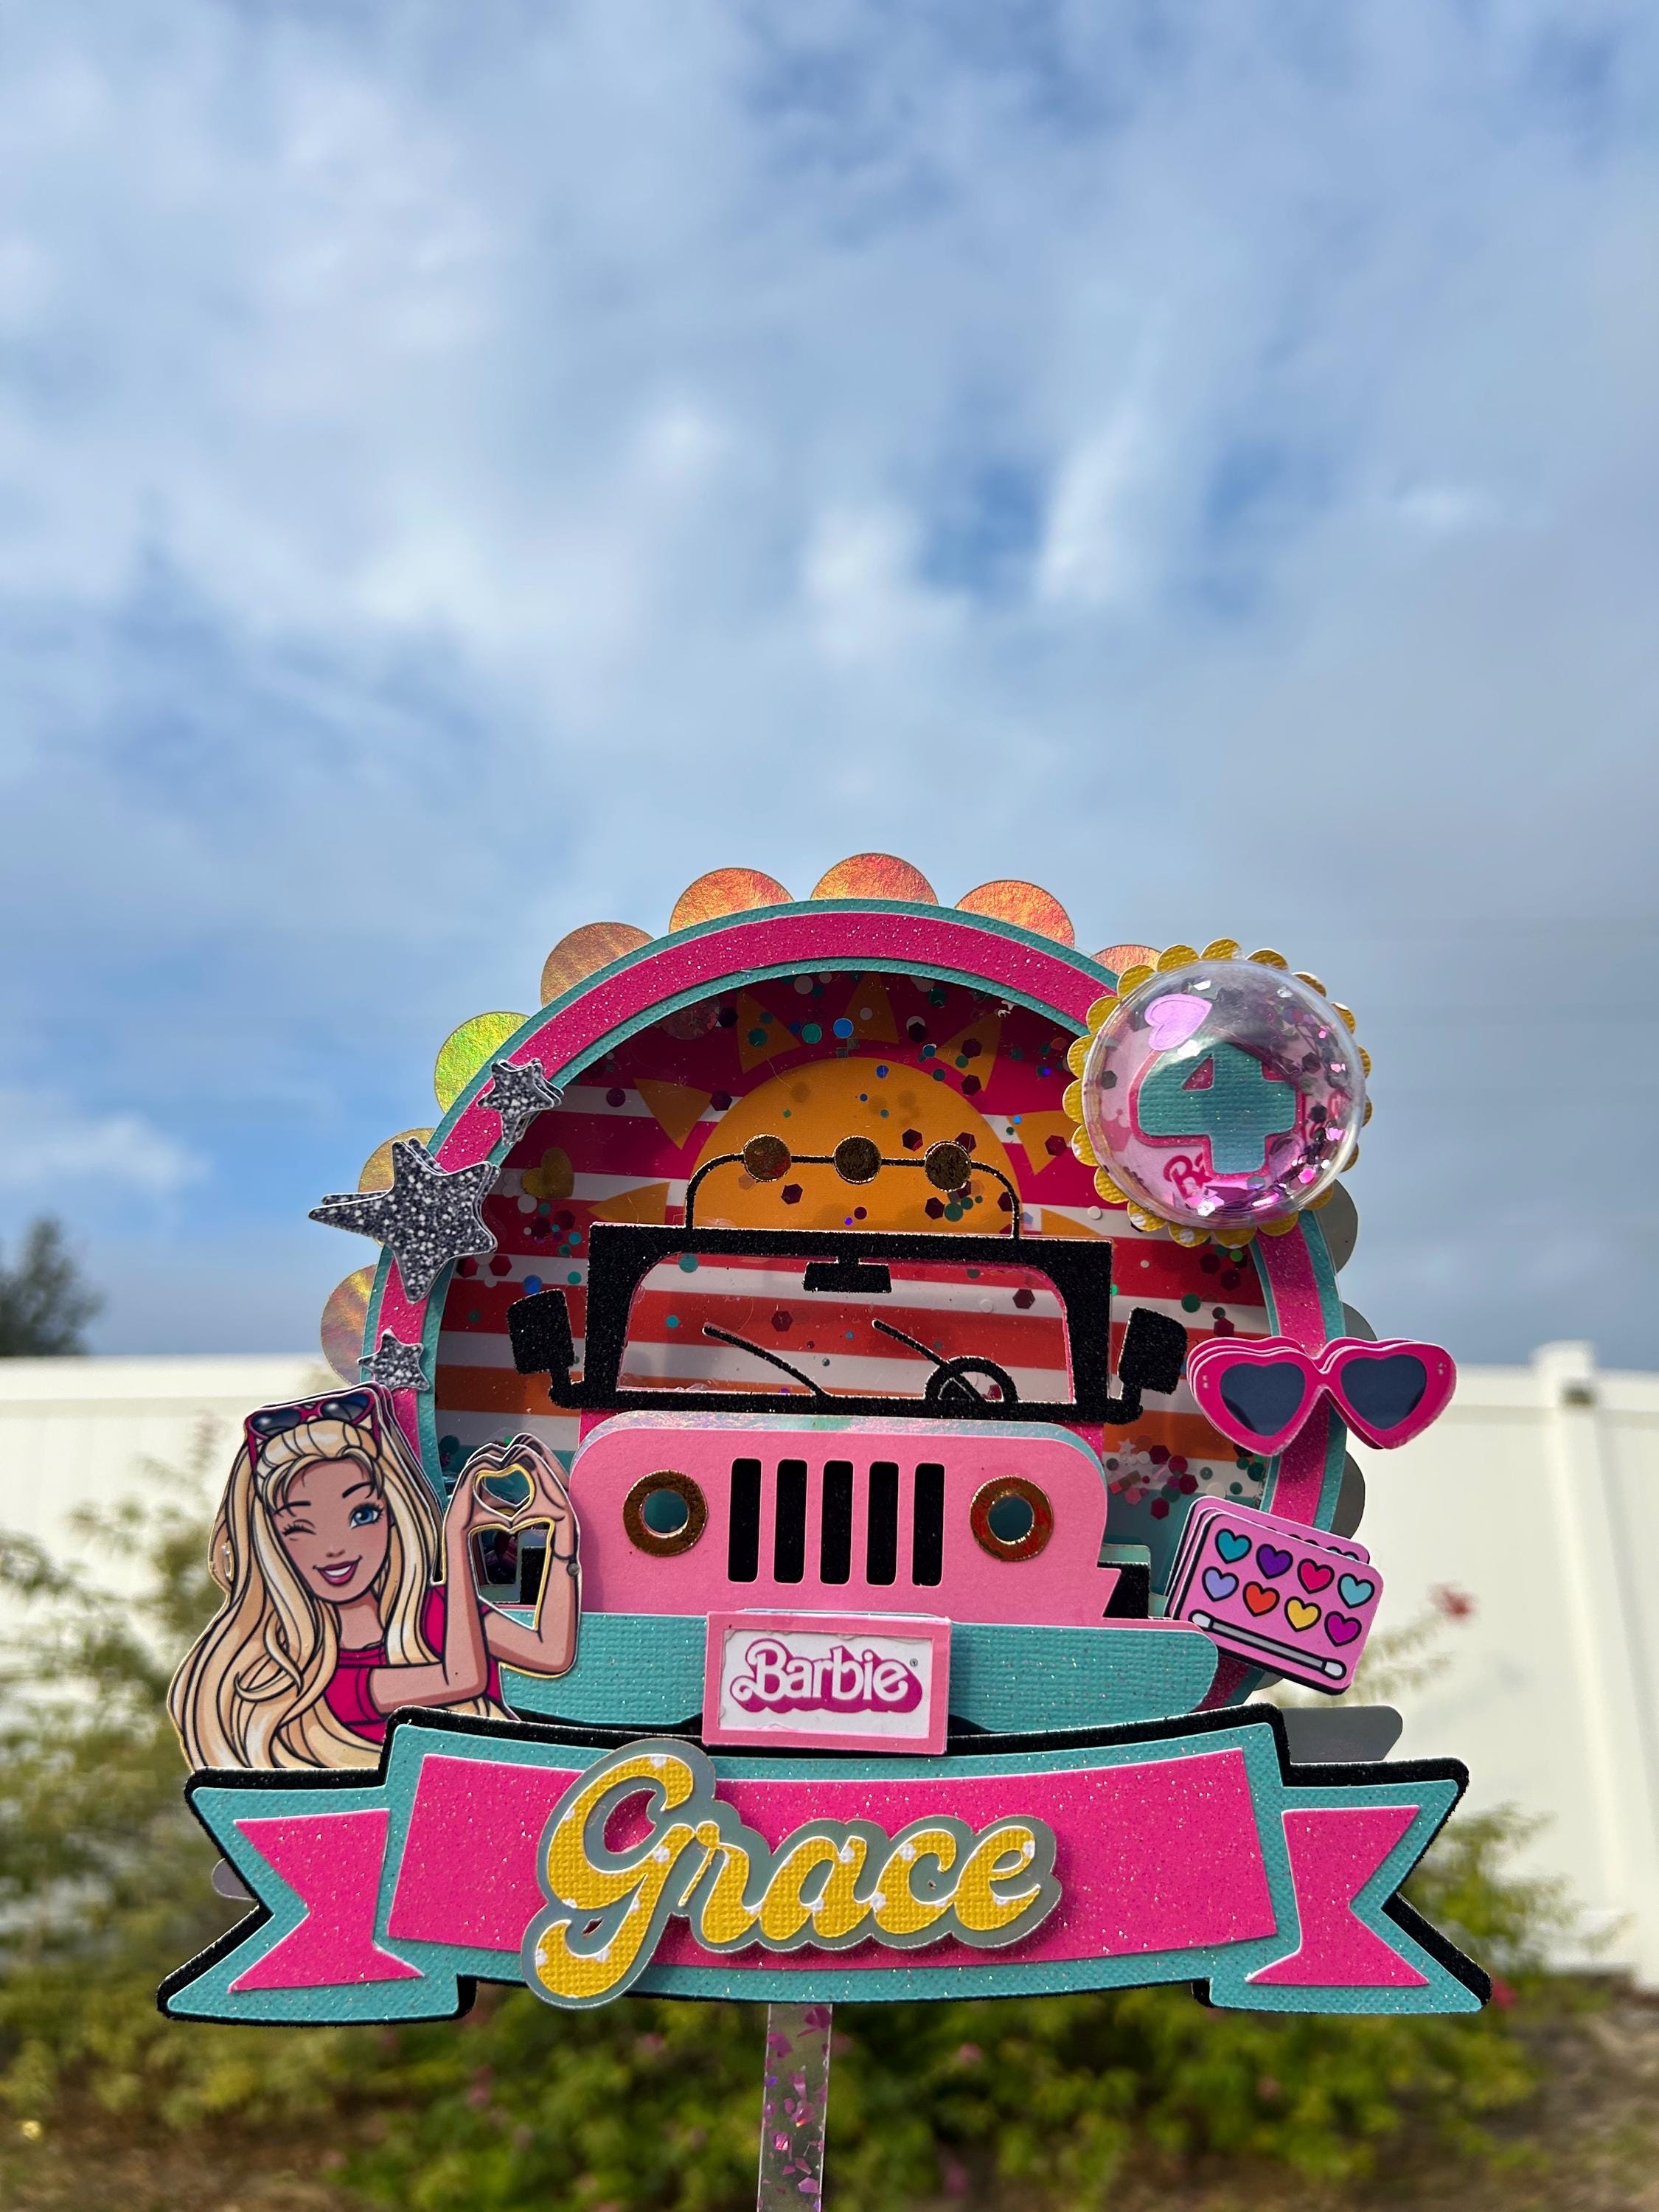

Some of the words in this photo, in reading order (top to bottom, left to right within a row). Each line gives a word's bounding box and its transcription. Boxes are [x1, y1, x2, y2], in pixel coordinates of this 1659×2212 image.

[1135, 1040, 1297, 1175] 4
[730, 1638, 921, 1711] Barbie
[535, 1753, 1041, 1998] Grace
